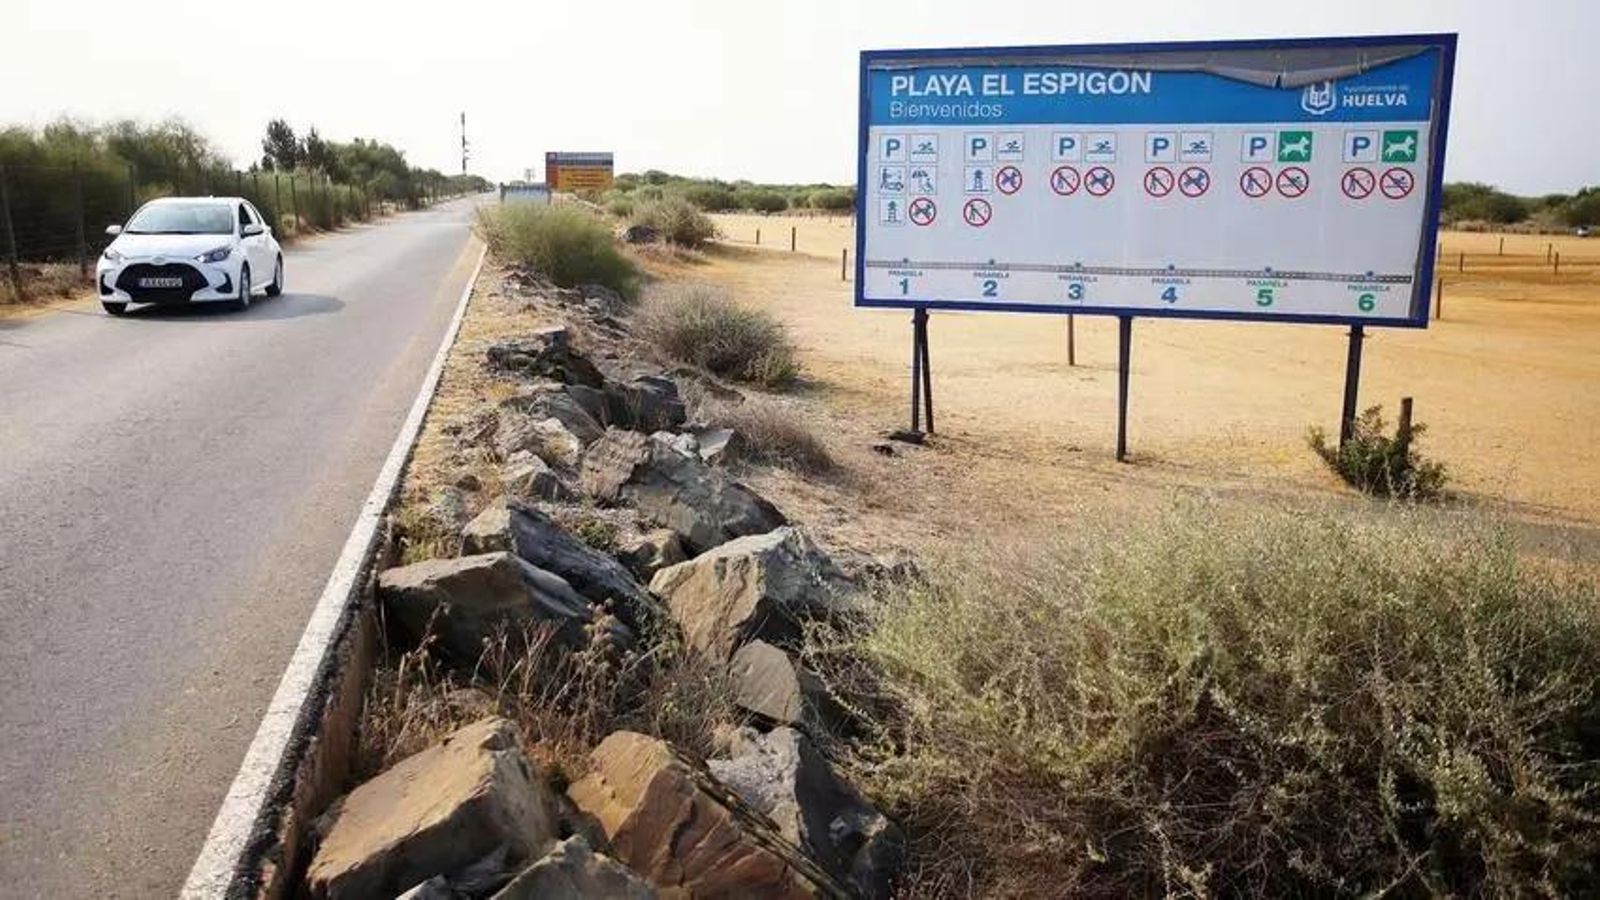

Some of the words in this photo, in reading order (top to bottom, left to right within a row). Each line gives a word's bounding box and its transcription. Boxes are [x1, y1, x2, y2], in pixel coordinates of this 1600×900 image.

[891, 74, 974, 97] PLAYA
[982, 73, 1015, 96] EL
[890, 100, 1002, 118] Bienvenidos
[1342, 93, 1408, 108] HUELVA
[886, 138, 901, 157] P
[971, 138, 987, 156] P
[1059, 137, 1075, 156] P
[1153, 137, 1169, 157] P
[1250, 137, 1267, 157] P
[1352, 136, 1370, 157] P
[899, 278, 909, 295] 1
[982, 280, 998, 297] 2
[1068, 283, 1083, 300] 3
[1161, 287, 1178, 303] 4
[1256, 289, 1274, 307] 5
[1358, 293, 1375, 312] 6
